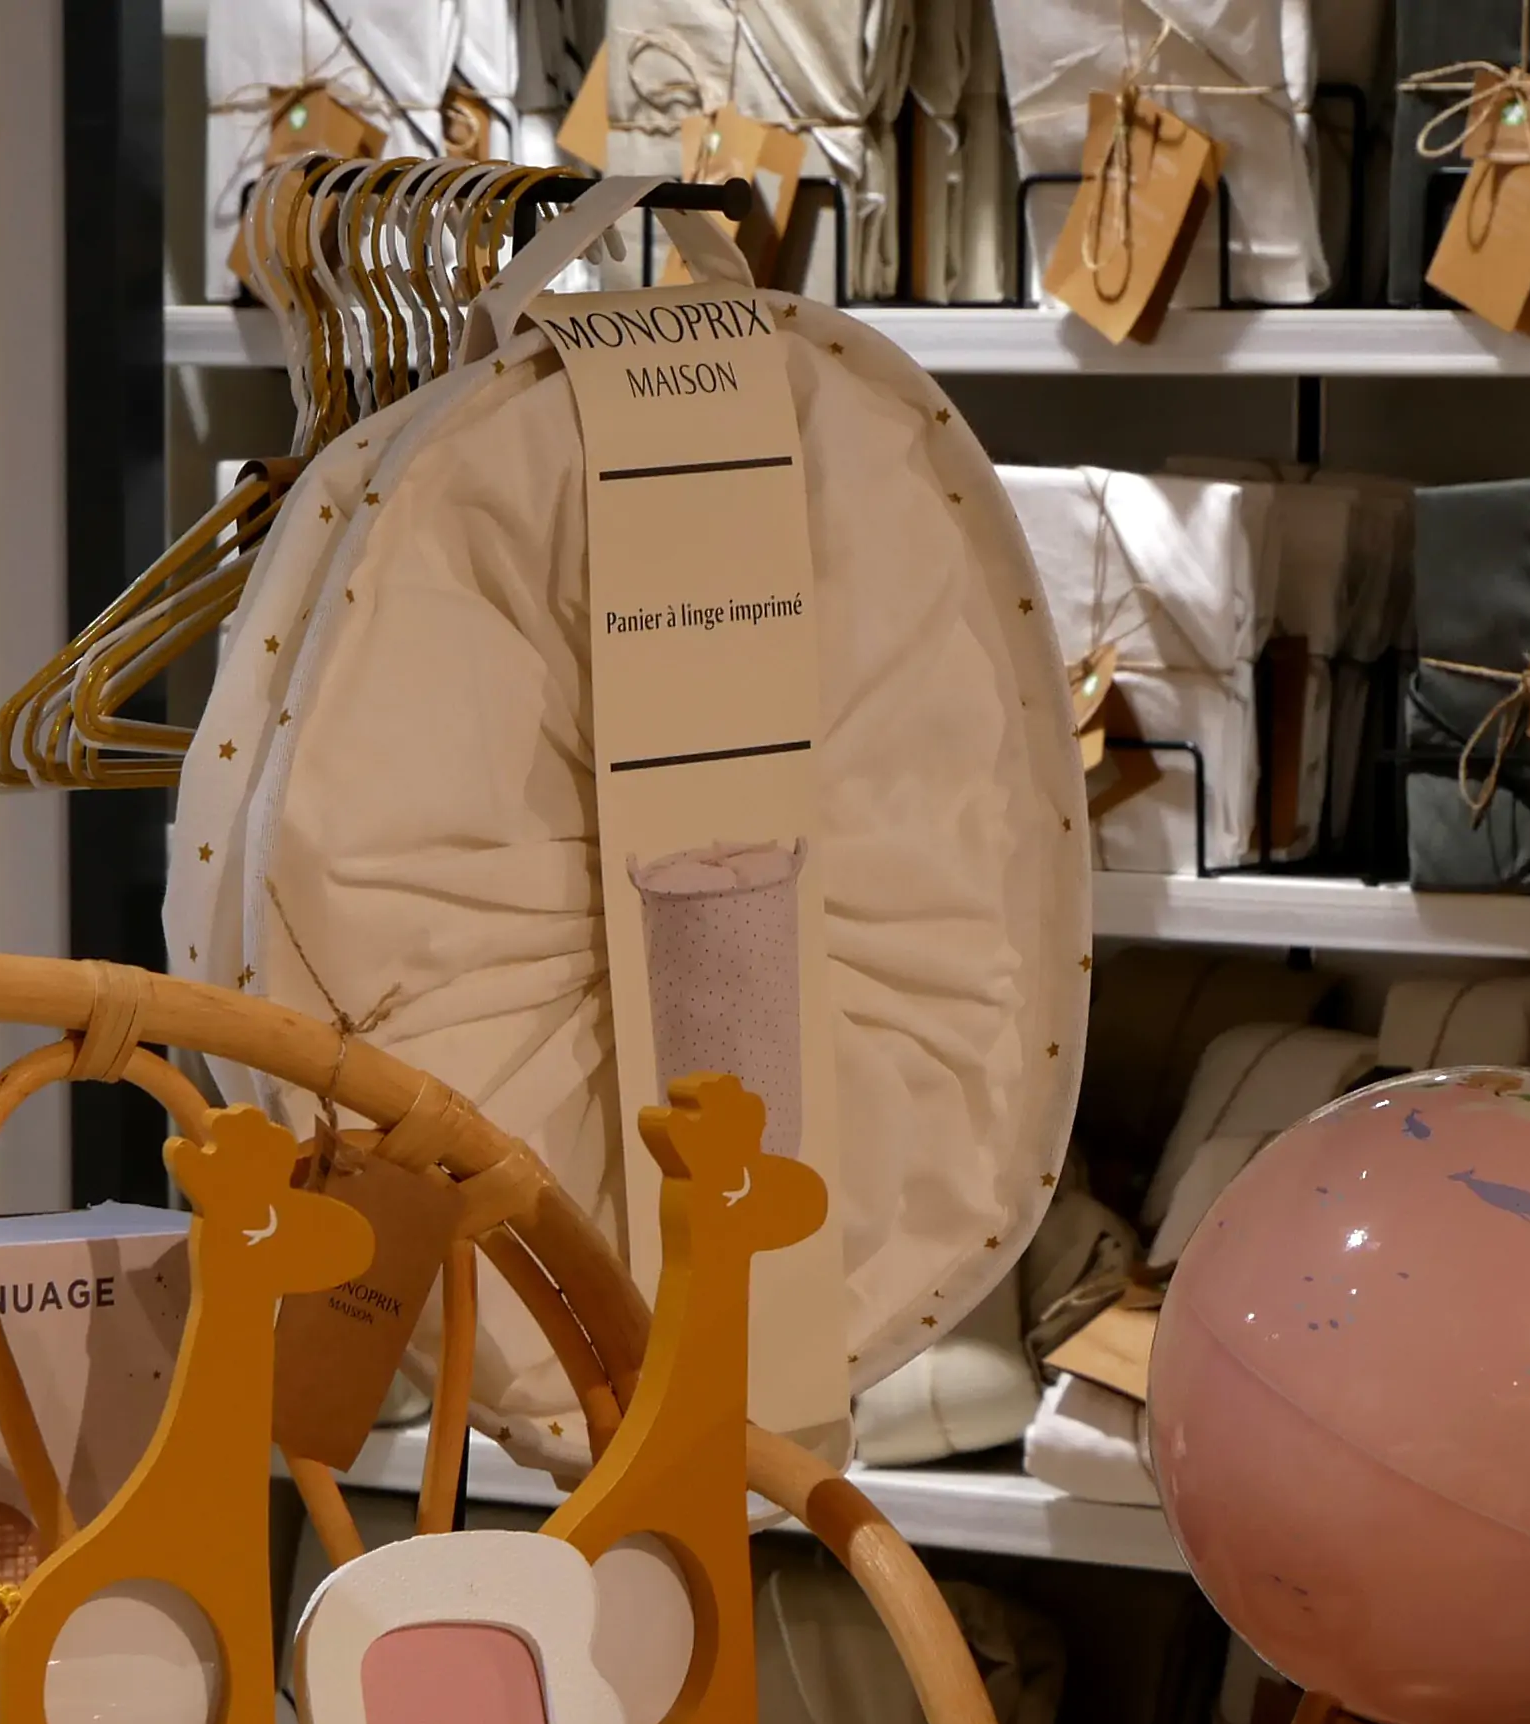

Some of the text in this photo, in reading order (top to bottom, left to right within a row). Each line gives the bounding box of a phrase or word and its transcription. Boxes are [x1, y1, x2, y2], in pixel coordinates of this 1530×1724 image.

[544, 299, 771, 350] MONOPRIX
[625, 361, 738, 398] MAISON
[606, 592, 803, 634] Panier à linge imprimé
[328, 1296, 374, 1325] MAISON
[334, 1281, 403, 1317] NOPRIX
